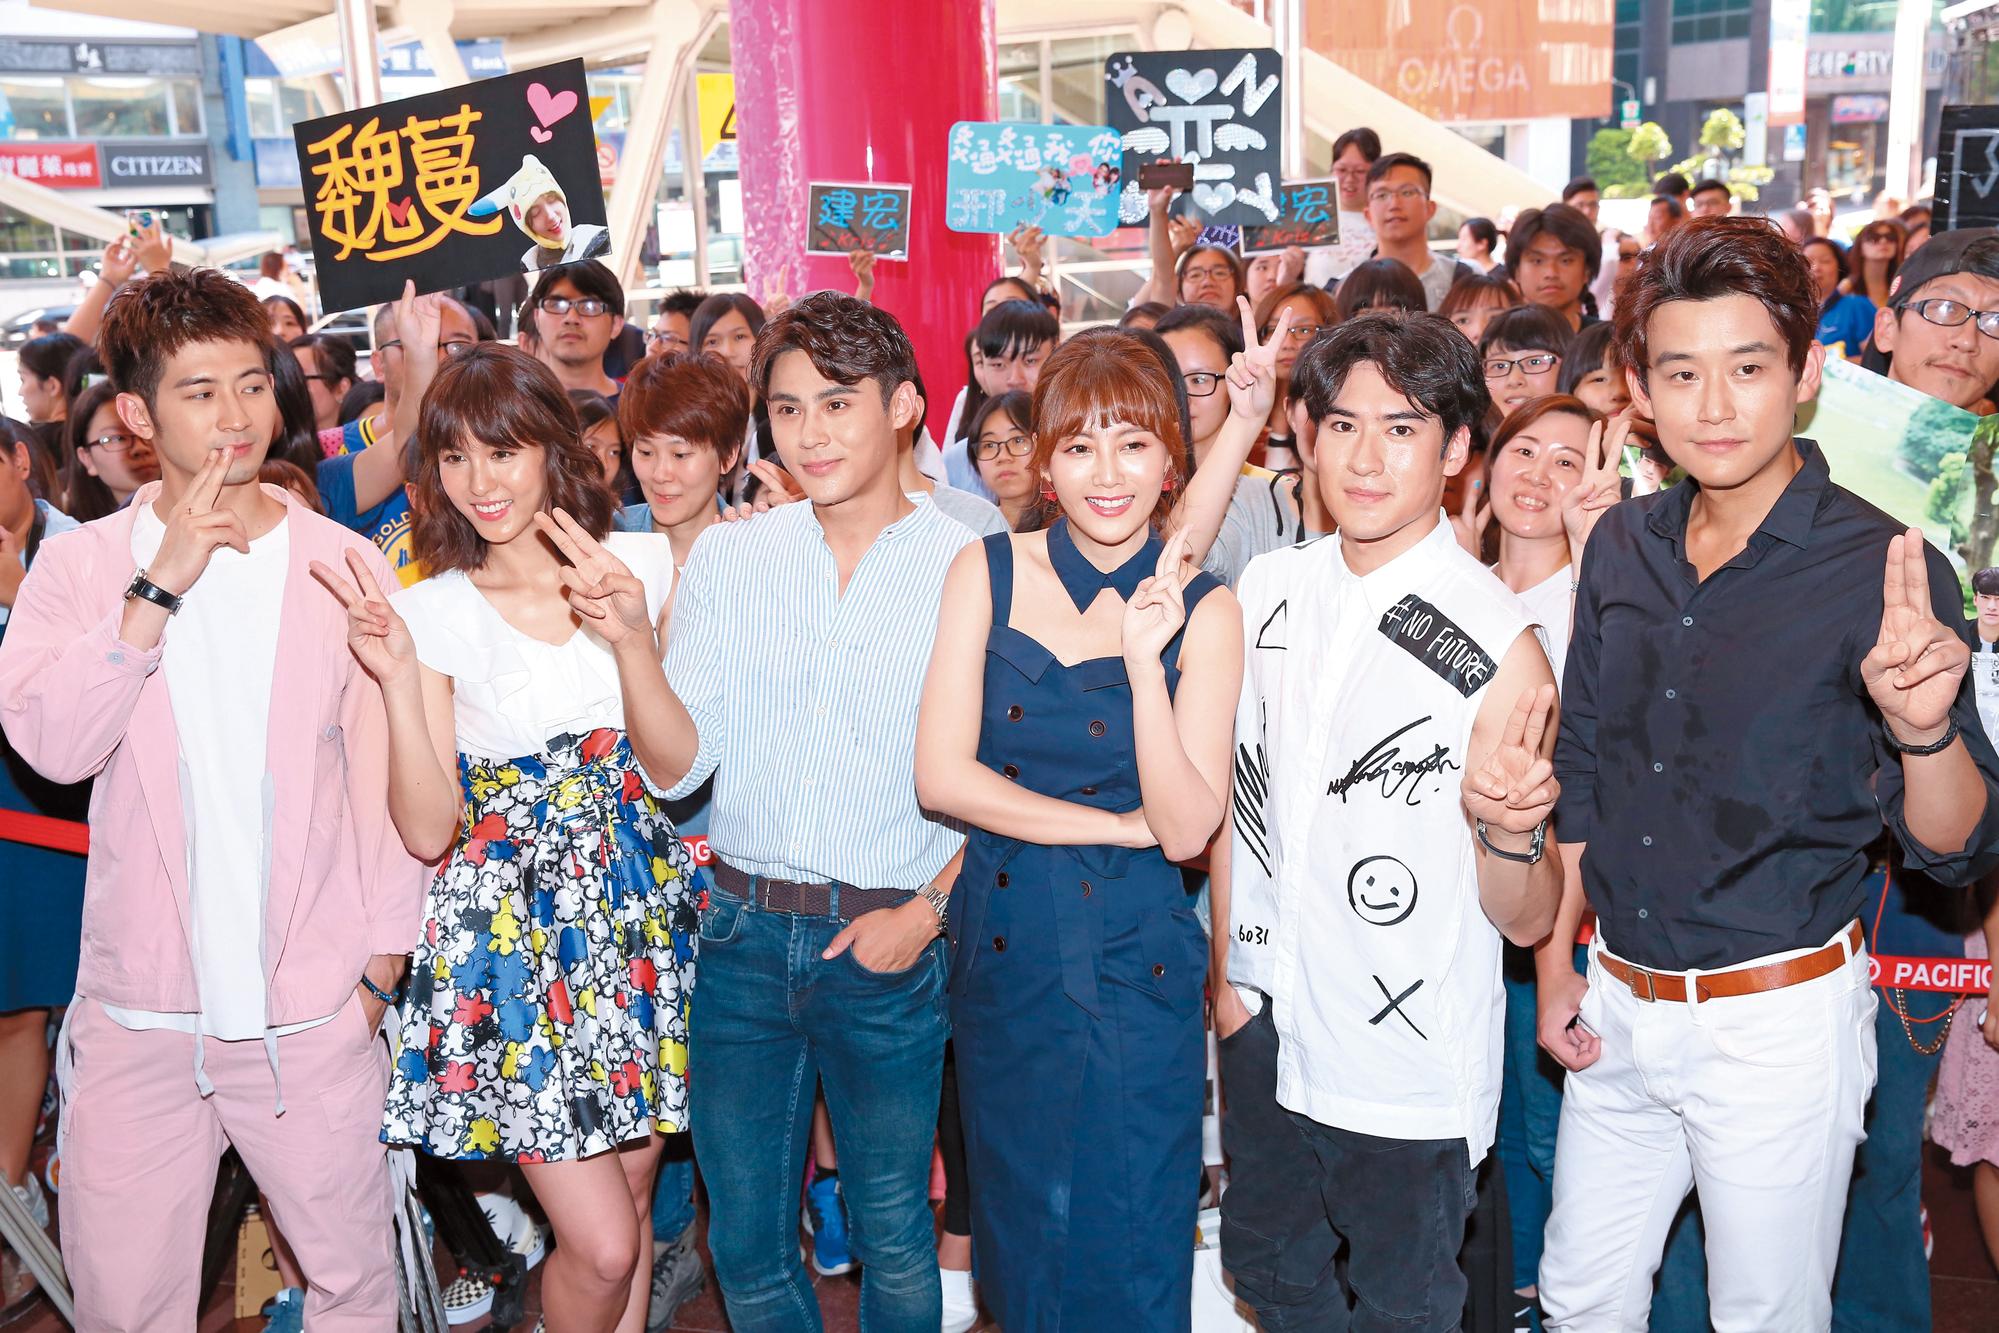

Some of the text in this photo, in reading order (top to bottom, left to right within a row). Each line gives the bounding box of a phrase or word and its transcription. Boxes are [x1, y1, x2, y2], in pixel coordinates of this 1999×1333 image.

[1398, 57, 1532, 95] OMEGA
[110, 156, 204, 176] CITIZEN
[307, 104, 503, 261] 魏蔓
[818, 189, 900, 230] 建宏
[1272, 229, 1311, 244] Kris
[1426, 627, 1488, 688] FUTURE
[1239, 924, 1269, 945] 6031
